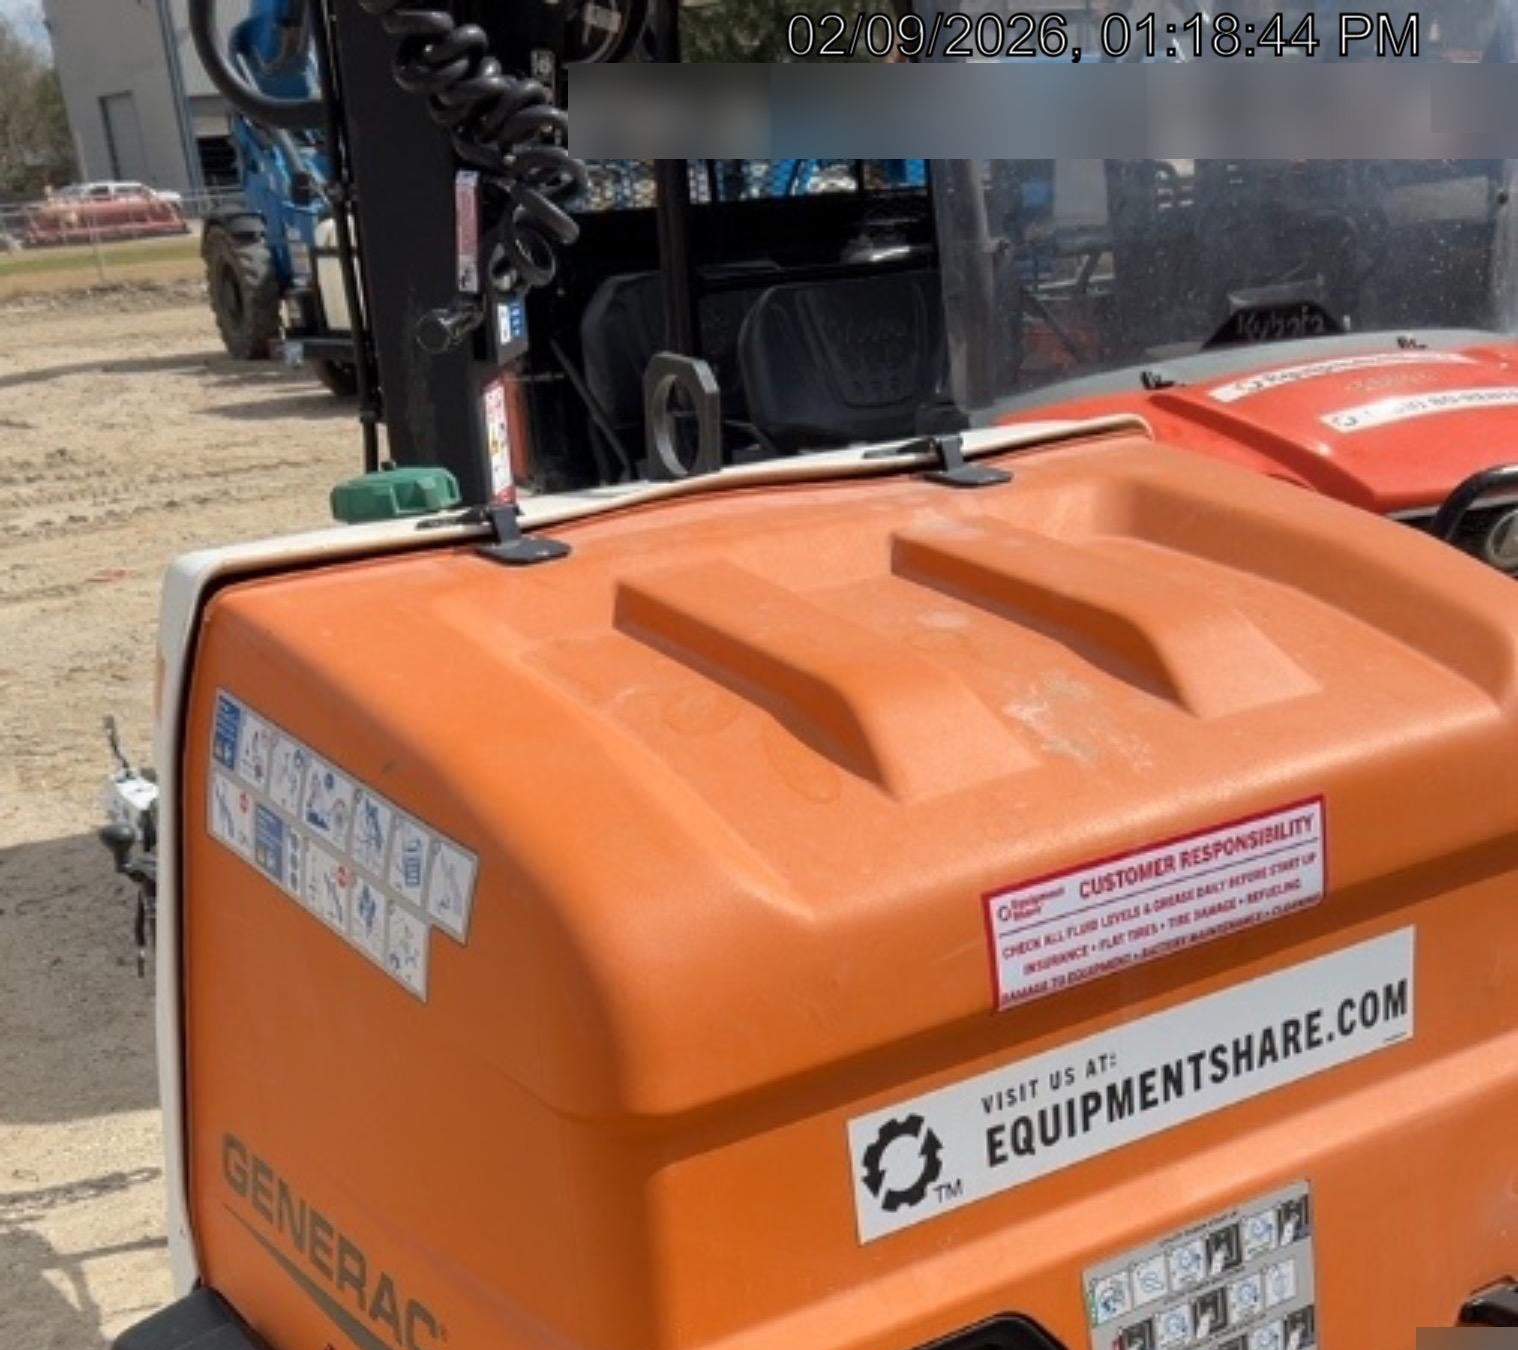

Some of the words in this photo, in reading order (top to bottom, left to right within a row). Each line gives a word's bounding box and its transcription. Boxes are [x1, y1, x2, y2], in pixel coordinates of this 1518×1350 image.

[1079, 858, 1176, 900] CUSTOMER
[1180, 812, 1315, 870] RESPONSIBILITY
[1002, 939, 1040, 960] CHECK
[1044, 931, 1064, 947] ALL
[1067, 920, 1098, 939] FLUID
[1101, 908, 1140, 928] LEVELS
[1153, 889, 1194, 911] GREASE
[1197, 879, 1225, 898] DAILY
[1229, 868, 1267, 888] BEFORE
[1269, 858, 1299, 876] START
[1302, 852, 1316, 866] UP
[1023, 944, 1088, 976] INSURANCE
[1100, 933, 1125, 951] FLAT
[1128, 922, 1158, 942] TIRES
[1168, 911, 1190, 928] TIRE
[1194, 898, 1236, 921] DAMAGE
[1247, 879, 1301, 904] REFUELING
[1052, 974, 1065, 987] TO
[981, 1079, 1039, 1115] VISIT
[1050, 1067, 1075, 1092] US
[1085, 1053, 1117, 1079] AT:
[987, 978, 1408, 1168] EQUIPMENTSHARE.COM
[934, 1180, 964, 1204] TM
